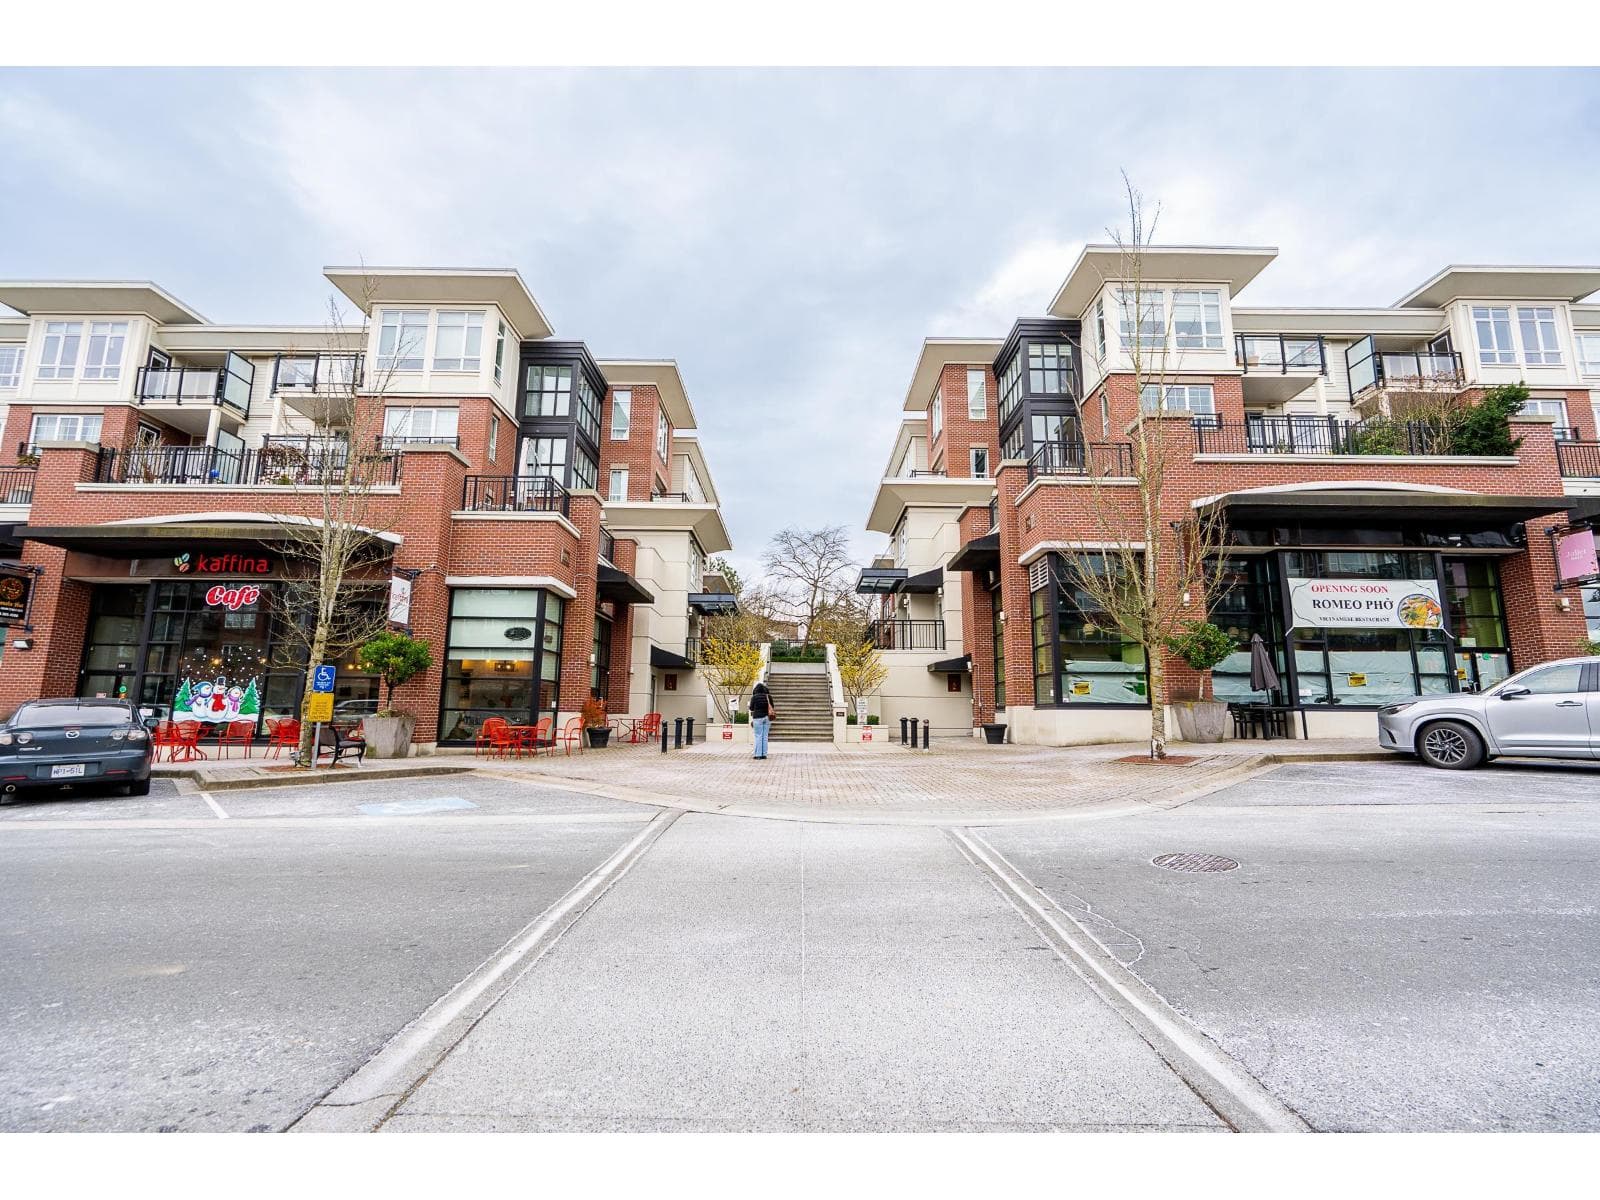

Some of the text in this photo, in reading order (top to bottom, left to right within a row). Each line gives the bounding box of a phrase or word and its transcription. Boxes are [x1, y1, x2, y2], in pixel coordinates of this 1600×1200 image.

[198, 554, 268, 572] kaffina
[1311, 585, 1388, 593] OPENING SOON
[206, 585, 259, 610] Café
[1312, 599, 1362, 610] ROMEO
